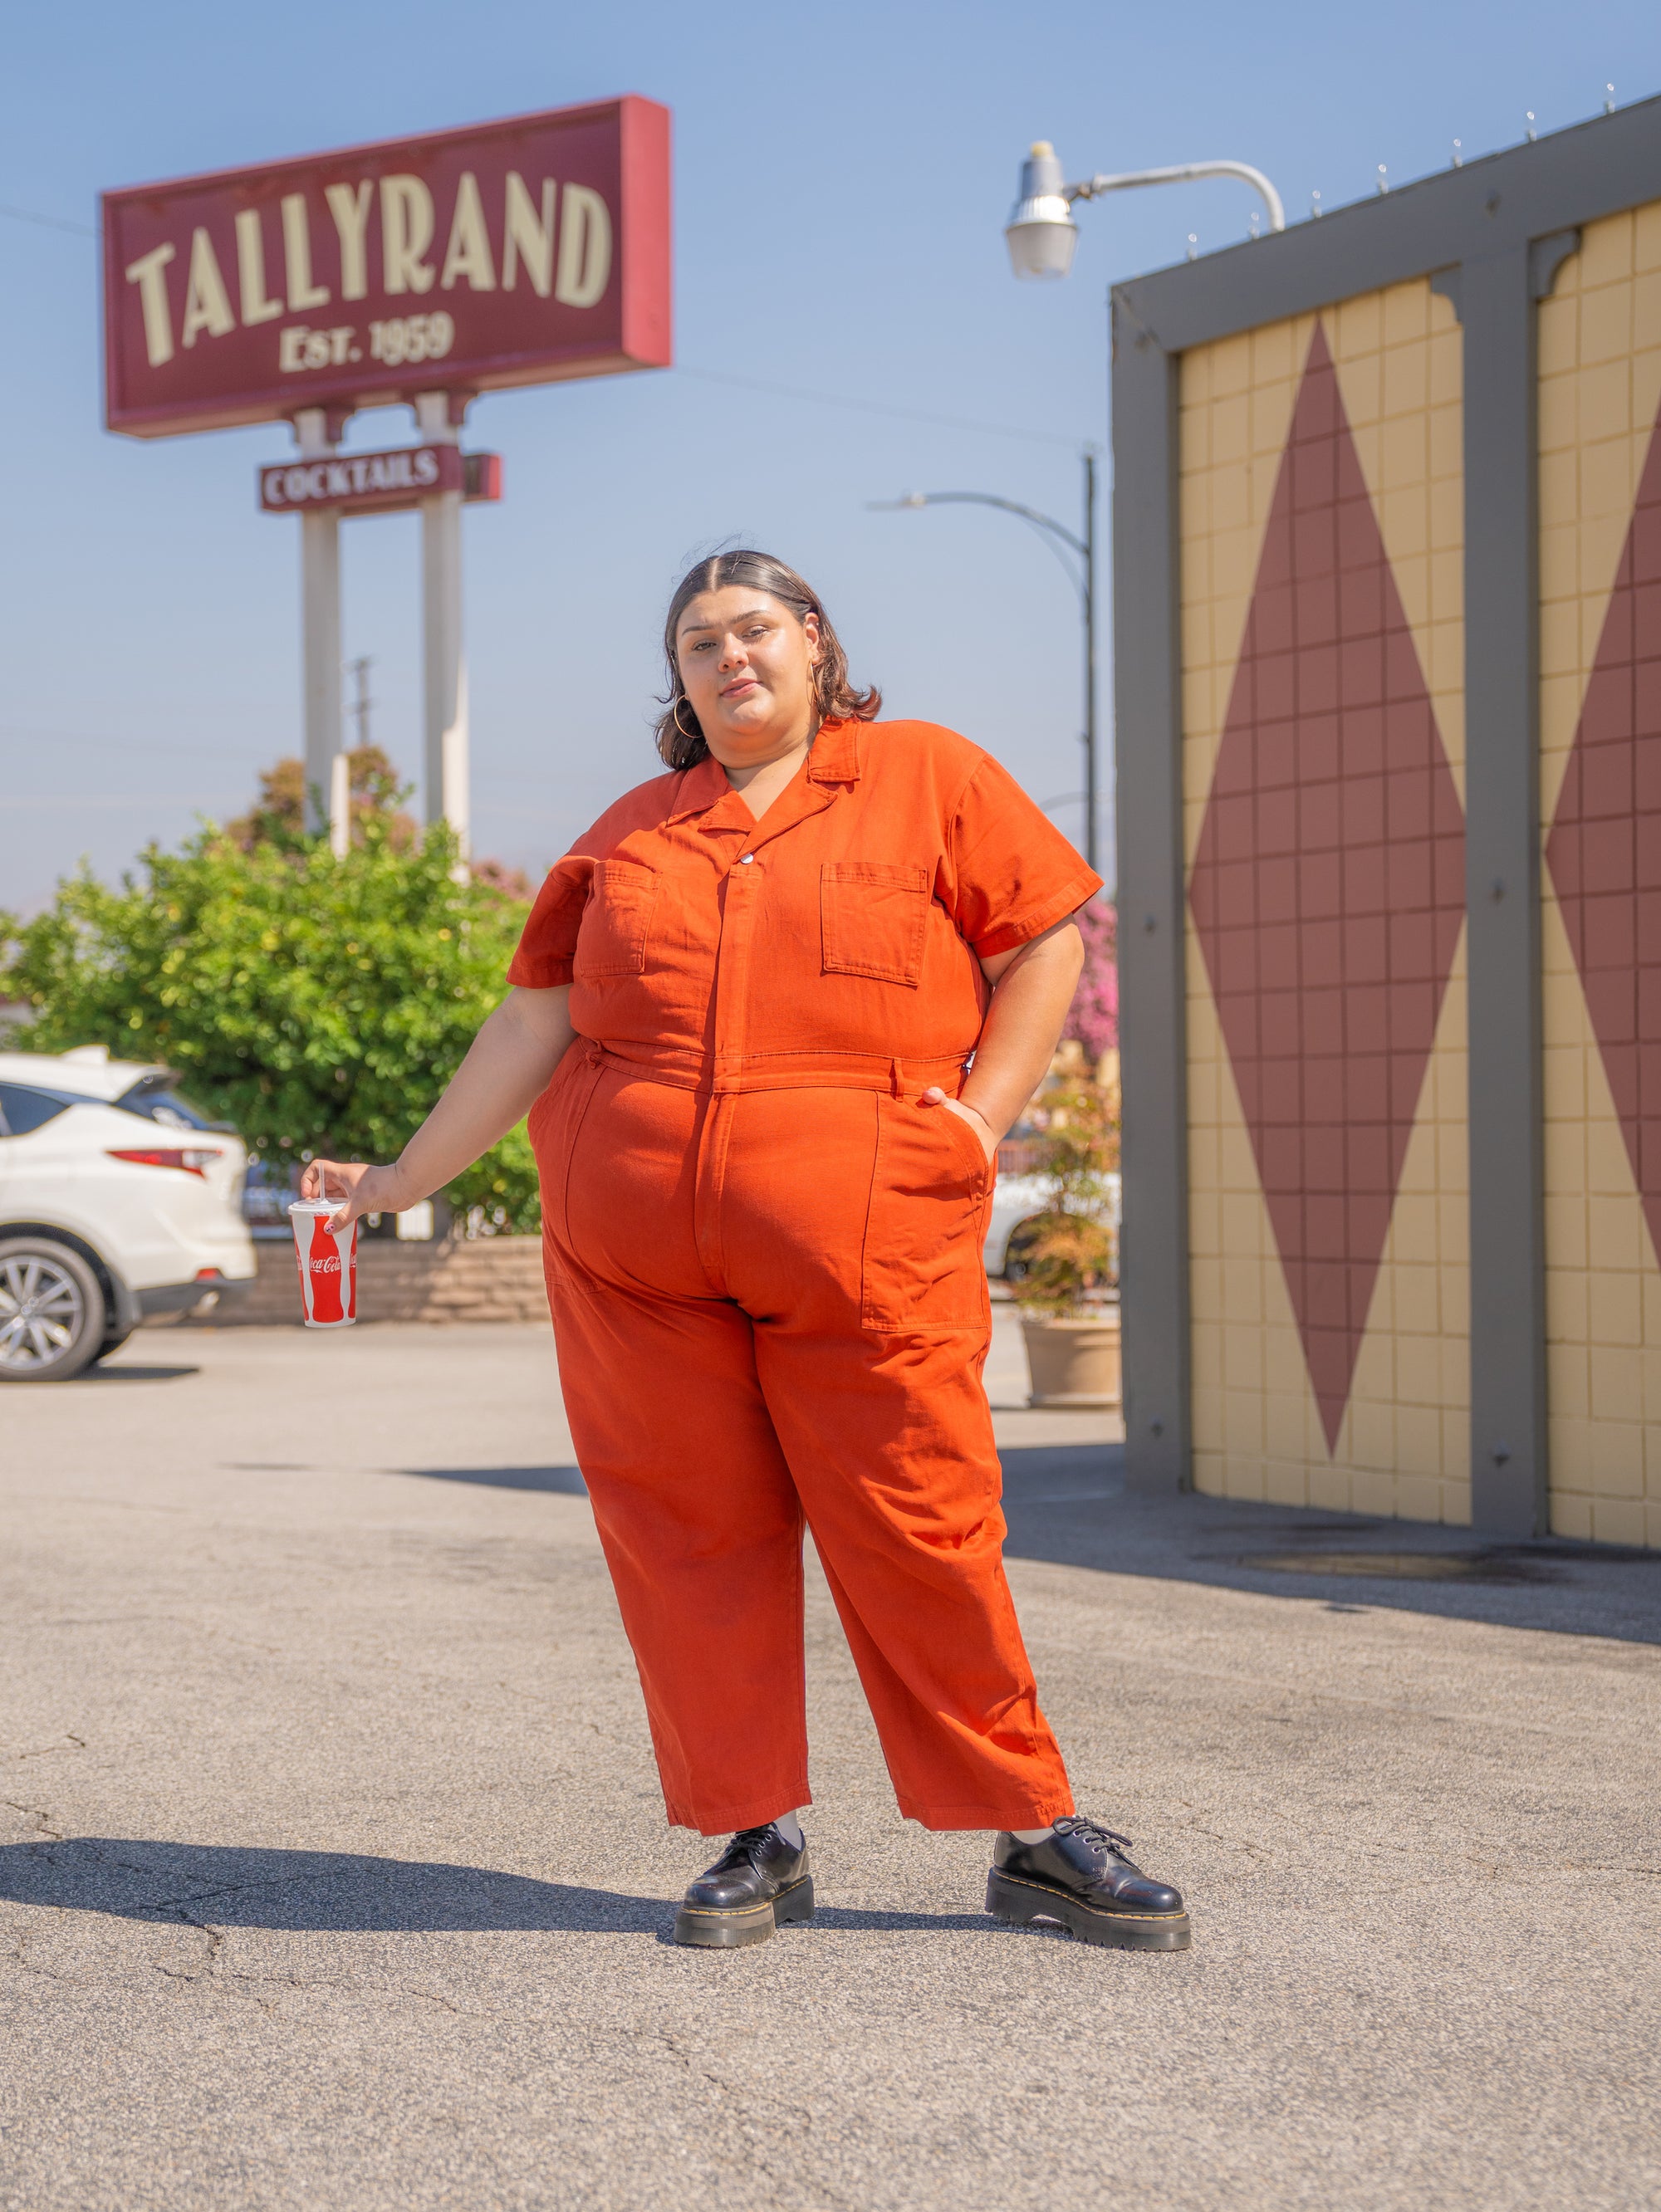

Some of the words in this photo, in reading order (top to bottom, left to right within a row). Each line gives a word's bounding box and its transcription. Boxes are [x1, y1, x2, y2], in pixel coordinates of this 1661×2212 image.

[125, 170, 613, 367] TALLYRAND
[368, 310, 455, 366] 1959
[264, 449, 439, 504] COCKTAILS
